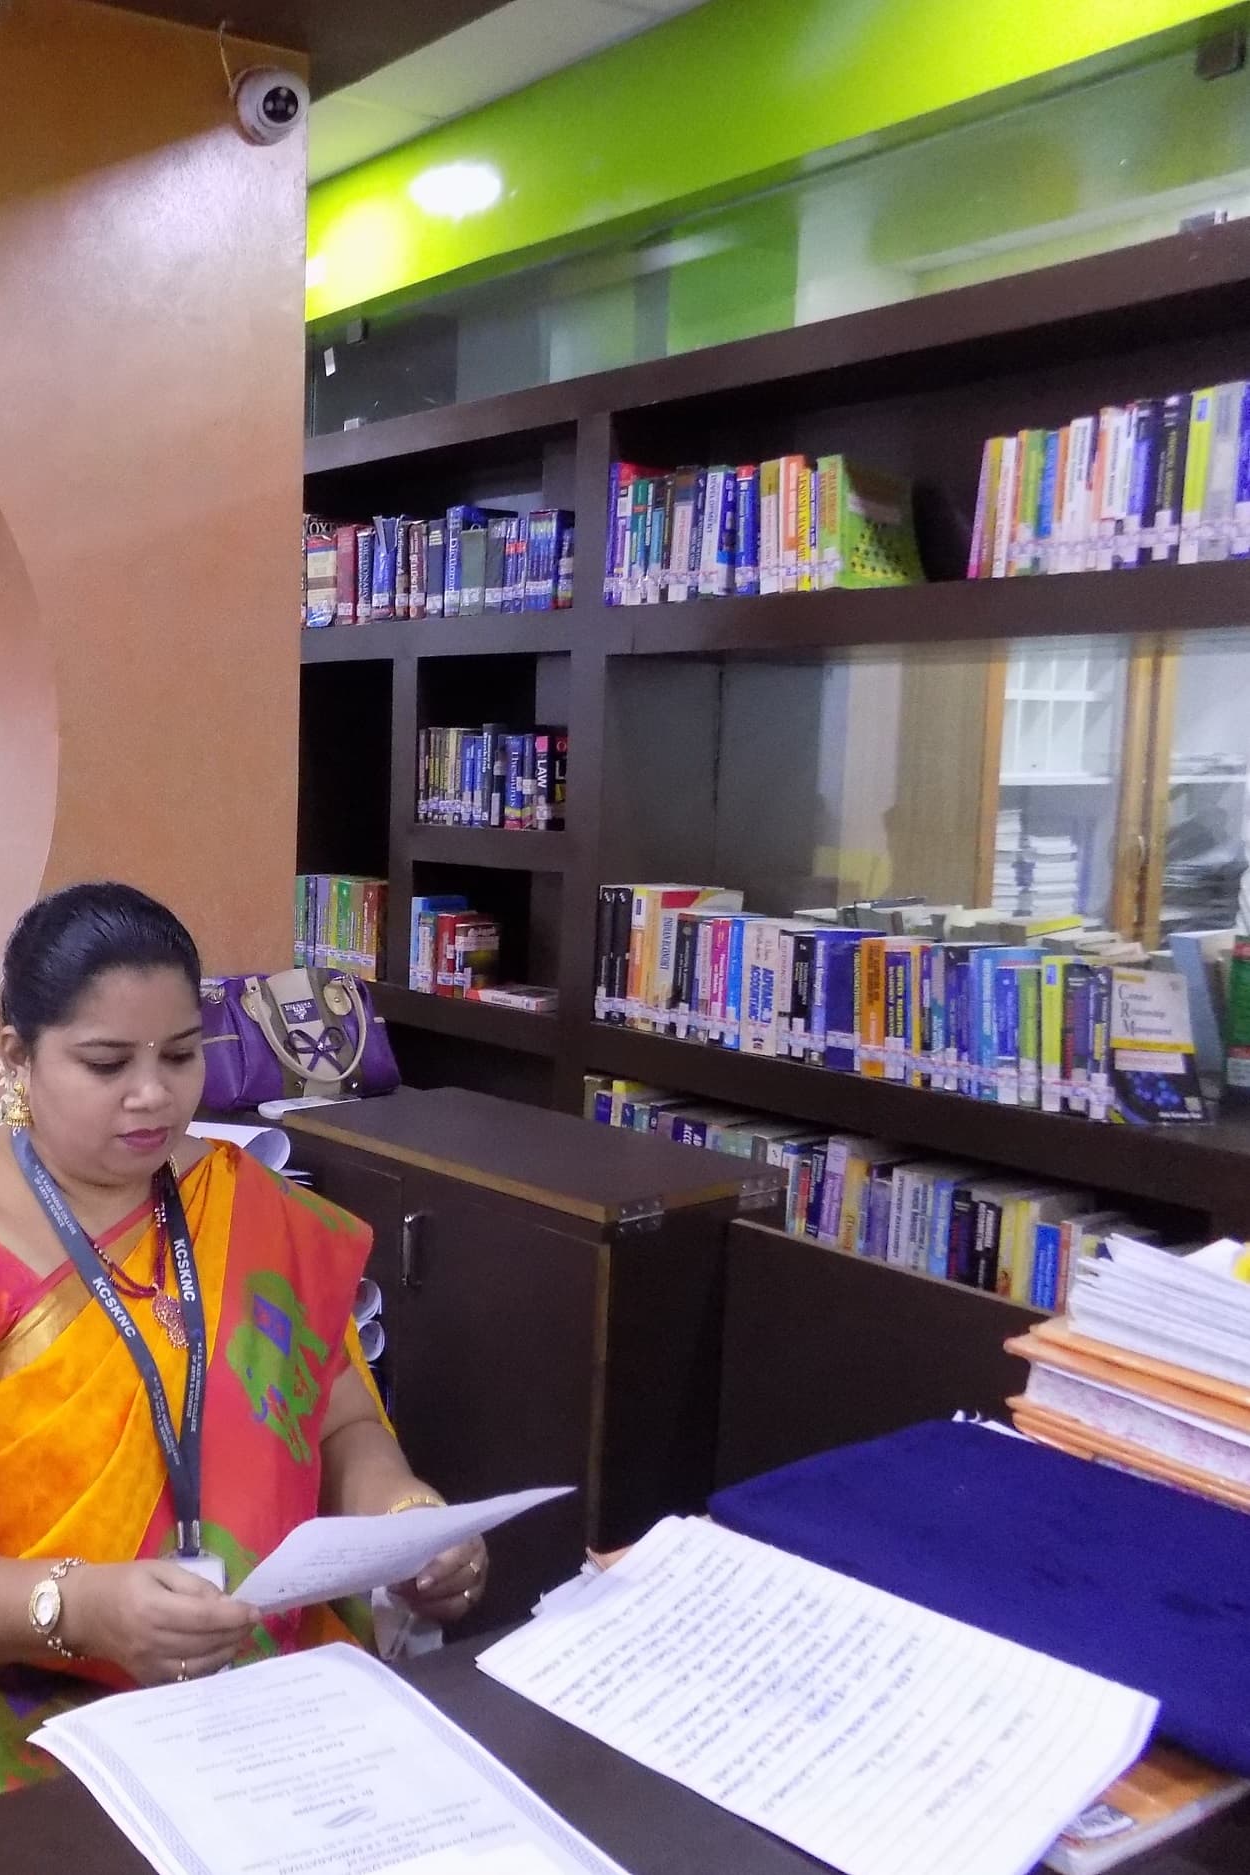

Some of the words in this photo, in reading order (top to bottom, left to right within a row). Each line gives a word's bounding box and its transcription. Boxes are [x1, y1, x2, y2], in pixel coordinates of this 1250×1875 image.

[509, 751, 519, 807] Thesaurus
[537, 760, 547, 788] LAW
[748, 965, 760, 1022] ACCOUNTANC
[761, 968, 775, 1024] ADVANCD
[173, 1238, 196, 1303] KCSKNC
[91, 1277, 136, 1340] KCSKNC
